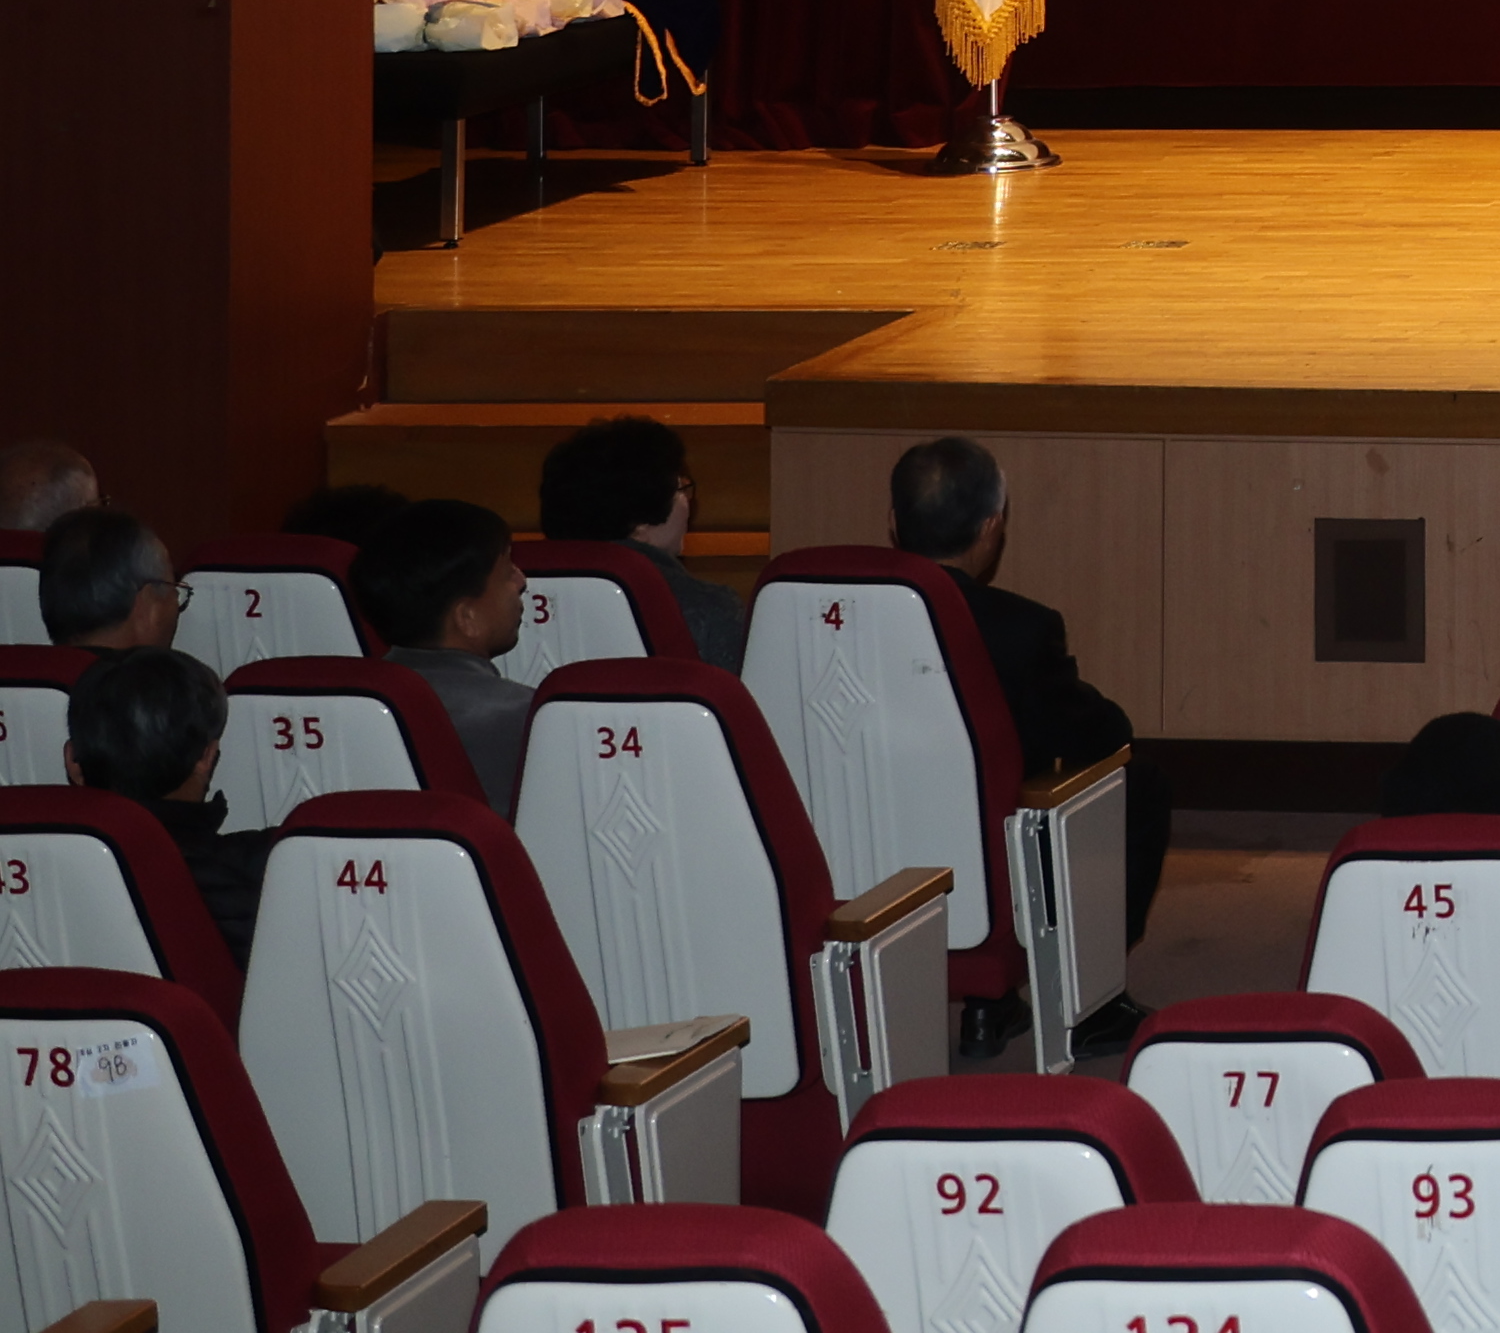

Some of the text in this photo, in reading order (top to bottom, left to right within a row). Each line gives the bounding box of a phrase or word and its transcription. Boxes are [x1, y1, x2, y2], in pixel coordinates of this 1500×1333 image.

[245, 589, 262, 618] 2
[533, 594, 550, 624] 3
[823, 602, 844, 631] 4
[273, 717, 323, 750] 35
[598, 727, 642, 759] 34
[0, 860, 29, 894] 3
[337, 861, 387, 893] 44
[1404, 885, 1454, 919] 45
[17, 1047, 73, 1087] 78
[1224, 1071, 1279, 1107] 77
[937, 1174, 1002, 1215] 92
[1412, 1174, 1475, 1219] 93
